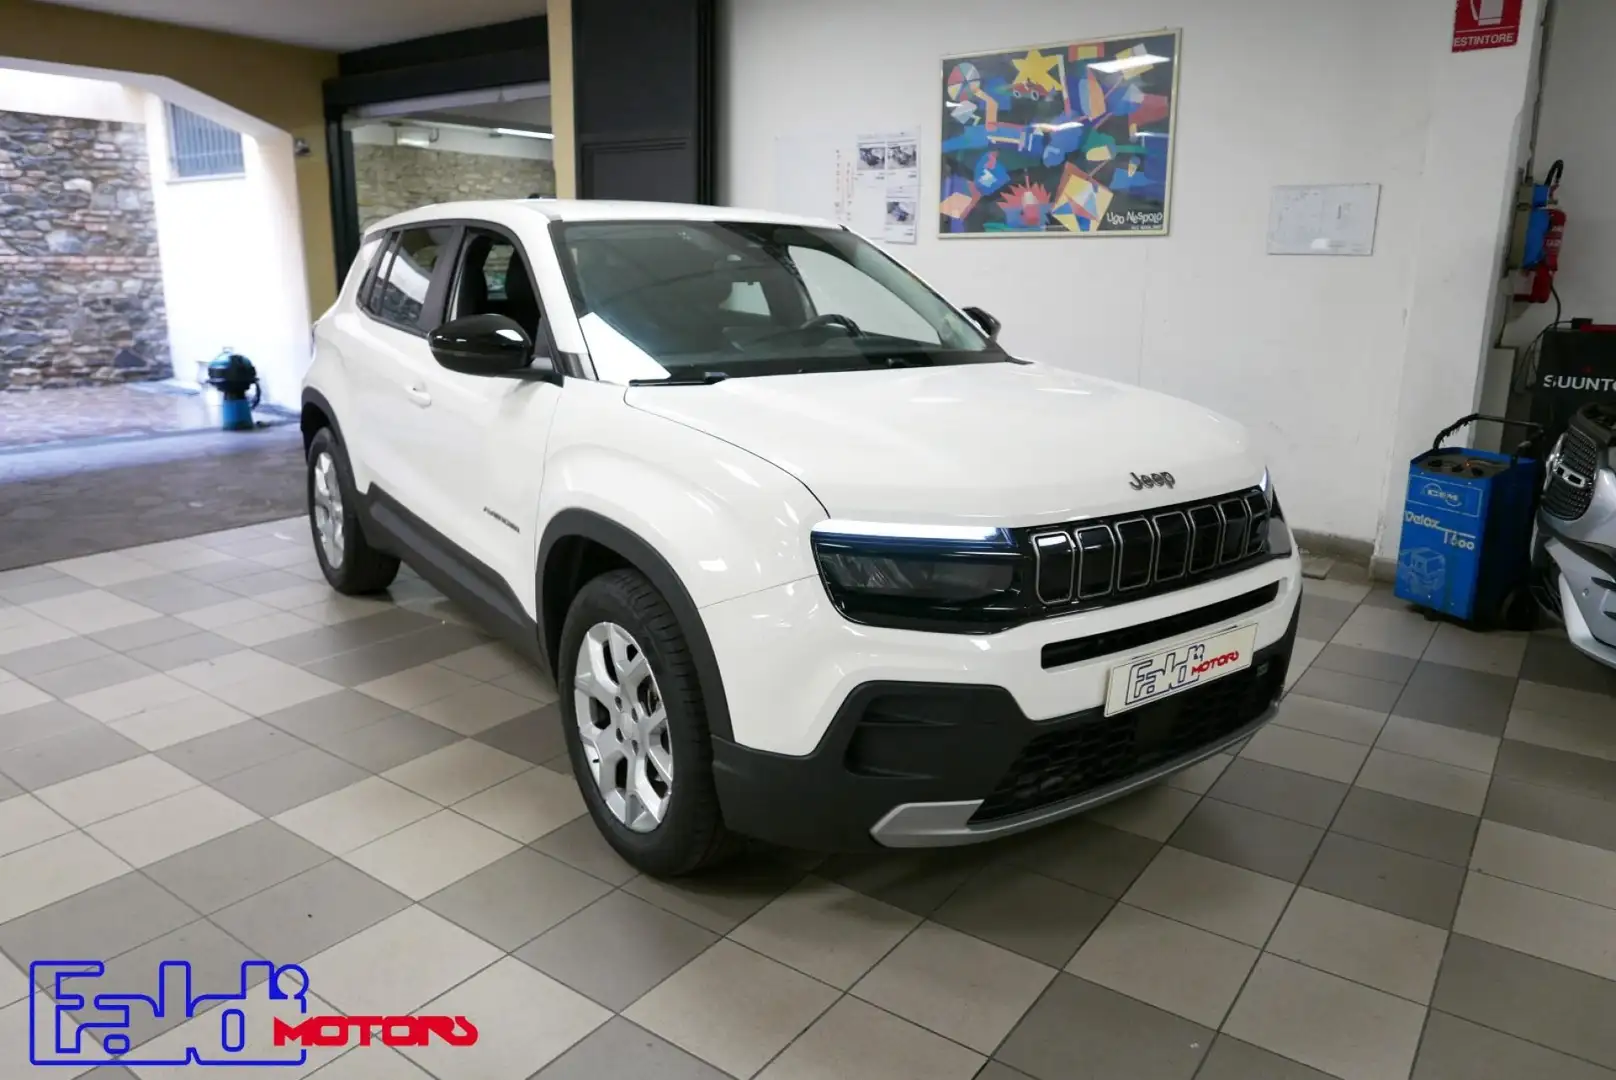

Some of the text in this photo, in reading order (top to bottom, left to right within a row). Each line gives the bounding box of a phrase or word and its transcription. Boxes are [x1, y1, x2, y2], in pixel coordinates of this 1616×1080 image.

[1454, 33, 1515, 46] ESTINTORE
[1106, 212, 1125, 225] Ugo
[1129, 472, 1175, 490] Jeep
